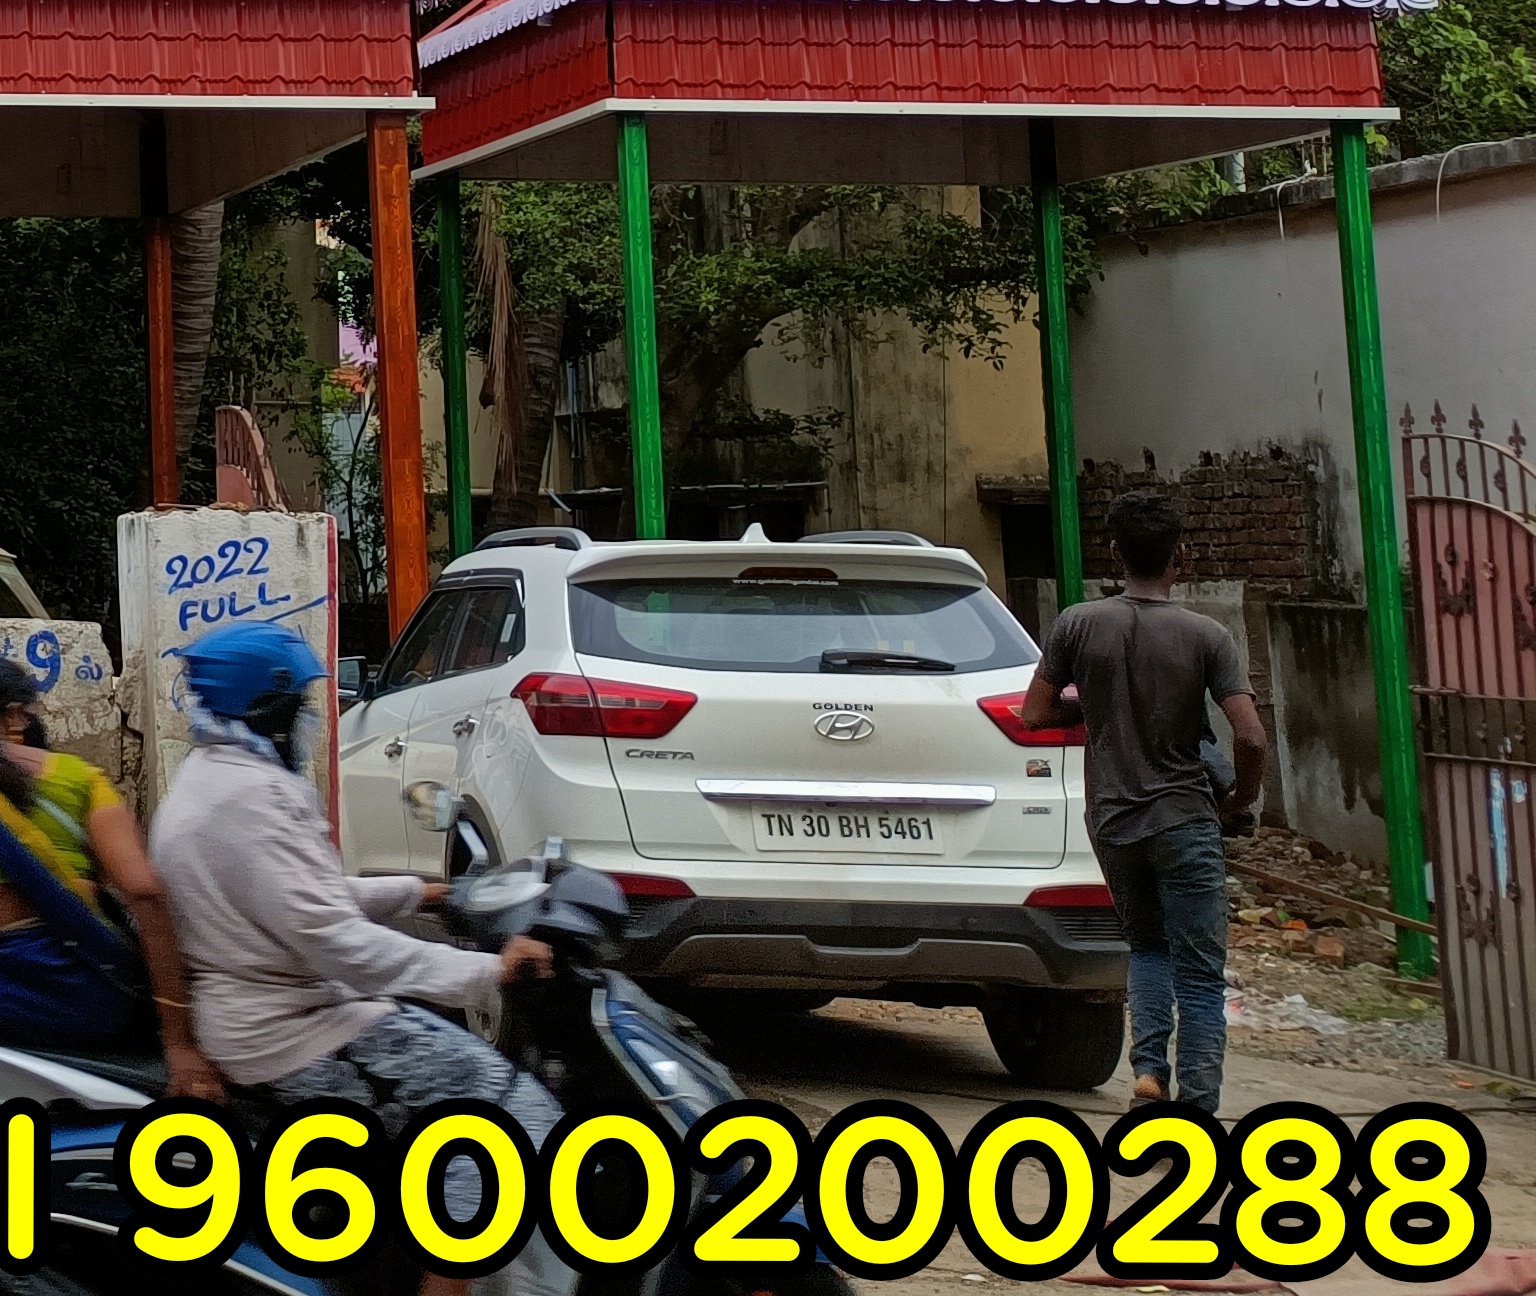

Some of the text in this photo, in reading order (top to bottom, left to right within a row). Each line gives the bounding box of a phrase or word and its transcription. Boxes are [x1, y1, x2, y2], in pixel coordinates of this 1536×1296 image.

[165, 536, 271, 596] 2022
[178, 581, 292, 632] FULL
[25, 630, 62, 693] 9
[812, 702, 874, 712] GOLDEN
[625, 748, 695, 761] CRETA
[761, 813, 934, 841] TN 30 BH 5461
